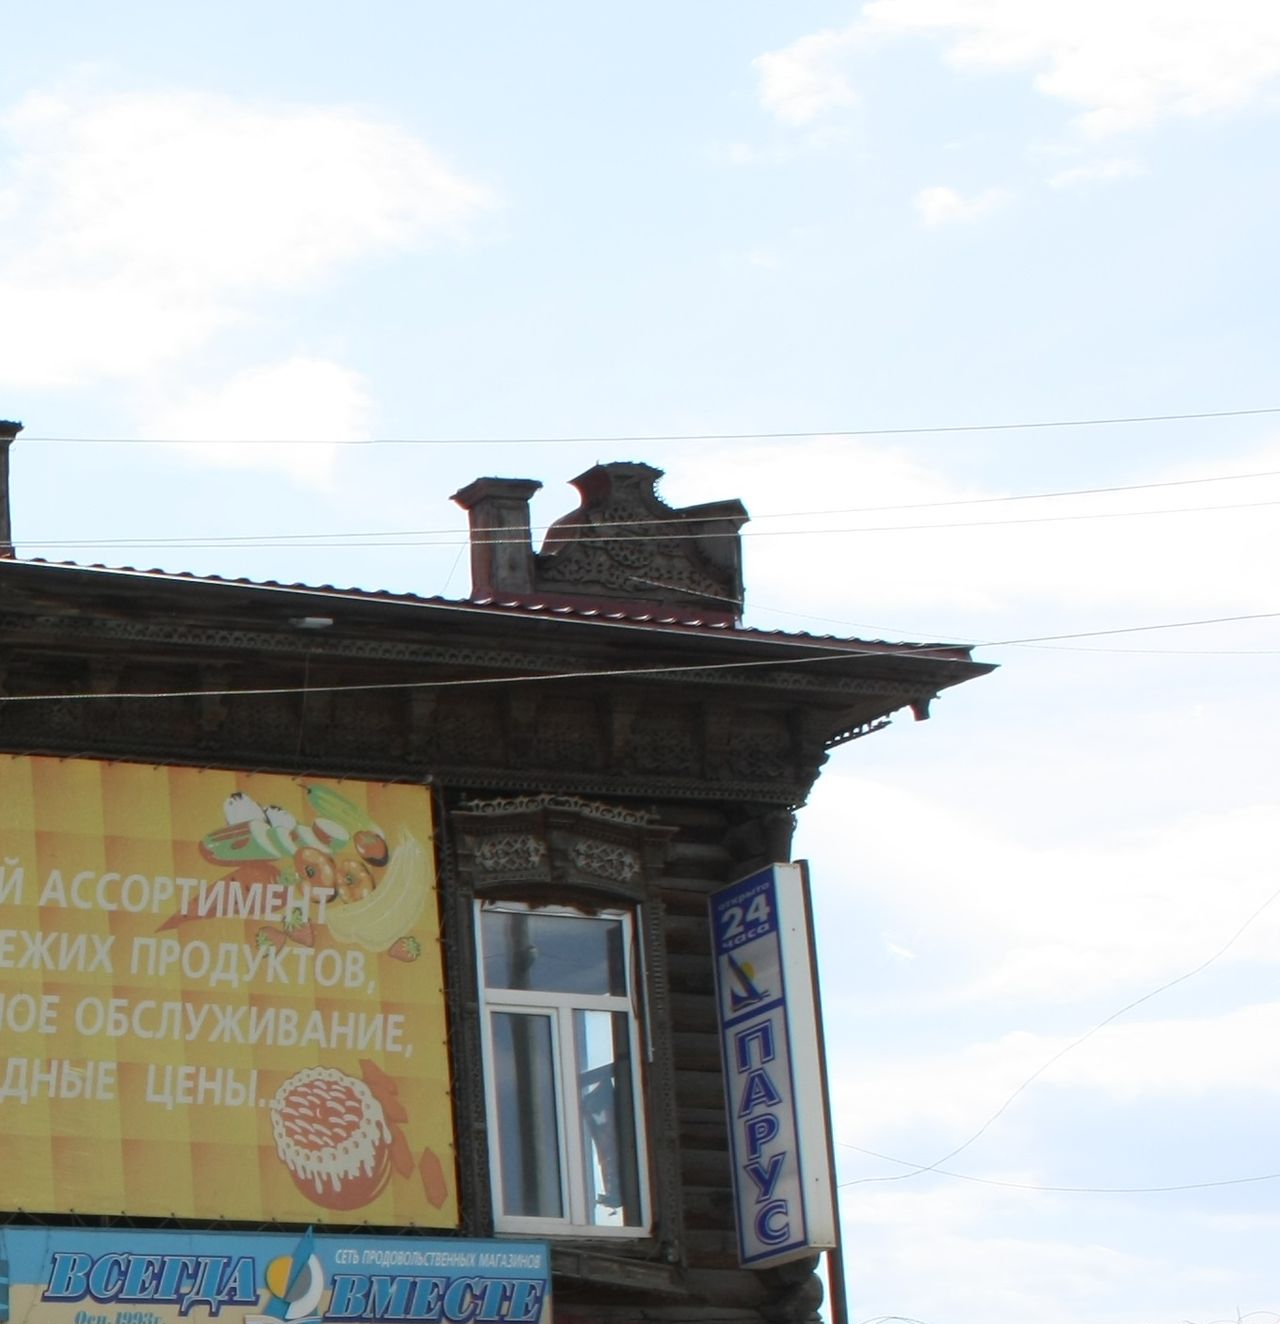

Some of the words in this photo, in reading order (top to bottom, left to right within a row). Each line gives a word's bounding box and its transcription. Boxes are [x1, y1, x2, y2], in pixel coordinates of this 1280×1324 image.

[40, 869, 335, 925] АССОРТИМЕНТ
[721, 893, 771, 940] 24
[130, 936, 376, 994] ПРОДУКТОВ,
[75, 996, 414, 1058] ОБСЛУЖИВАНИЕ,
[737, 1019, 789, 1244] ПАРУС
[41, 1252, 260, 1317] ВСЕГДА
[335, 1249, 360, 1265] СЕТЬ
[362, 1250, 476, 1268] ПРОДОВОЛЬСТВЕННЫХ
[479, 1252, 541, 1269] МАГАЗИНОВ
